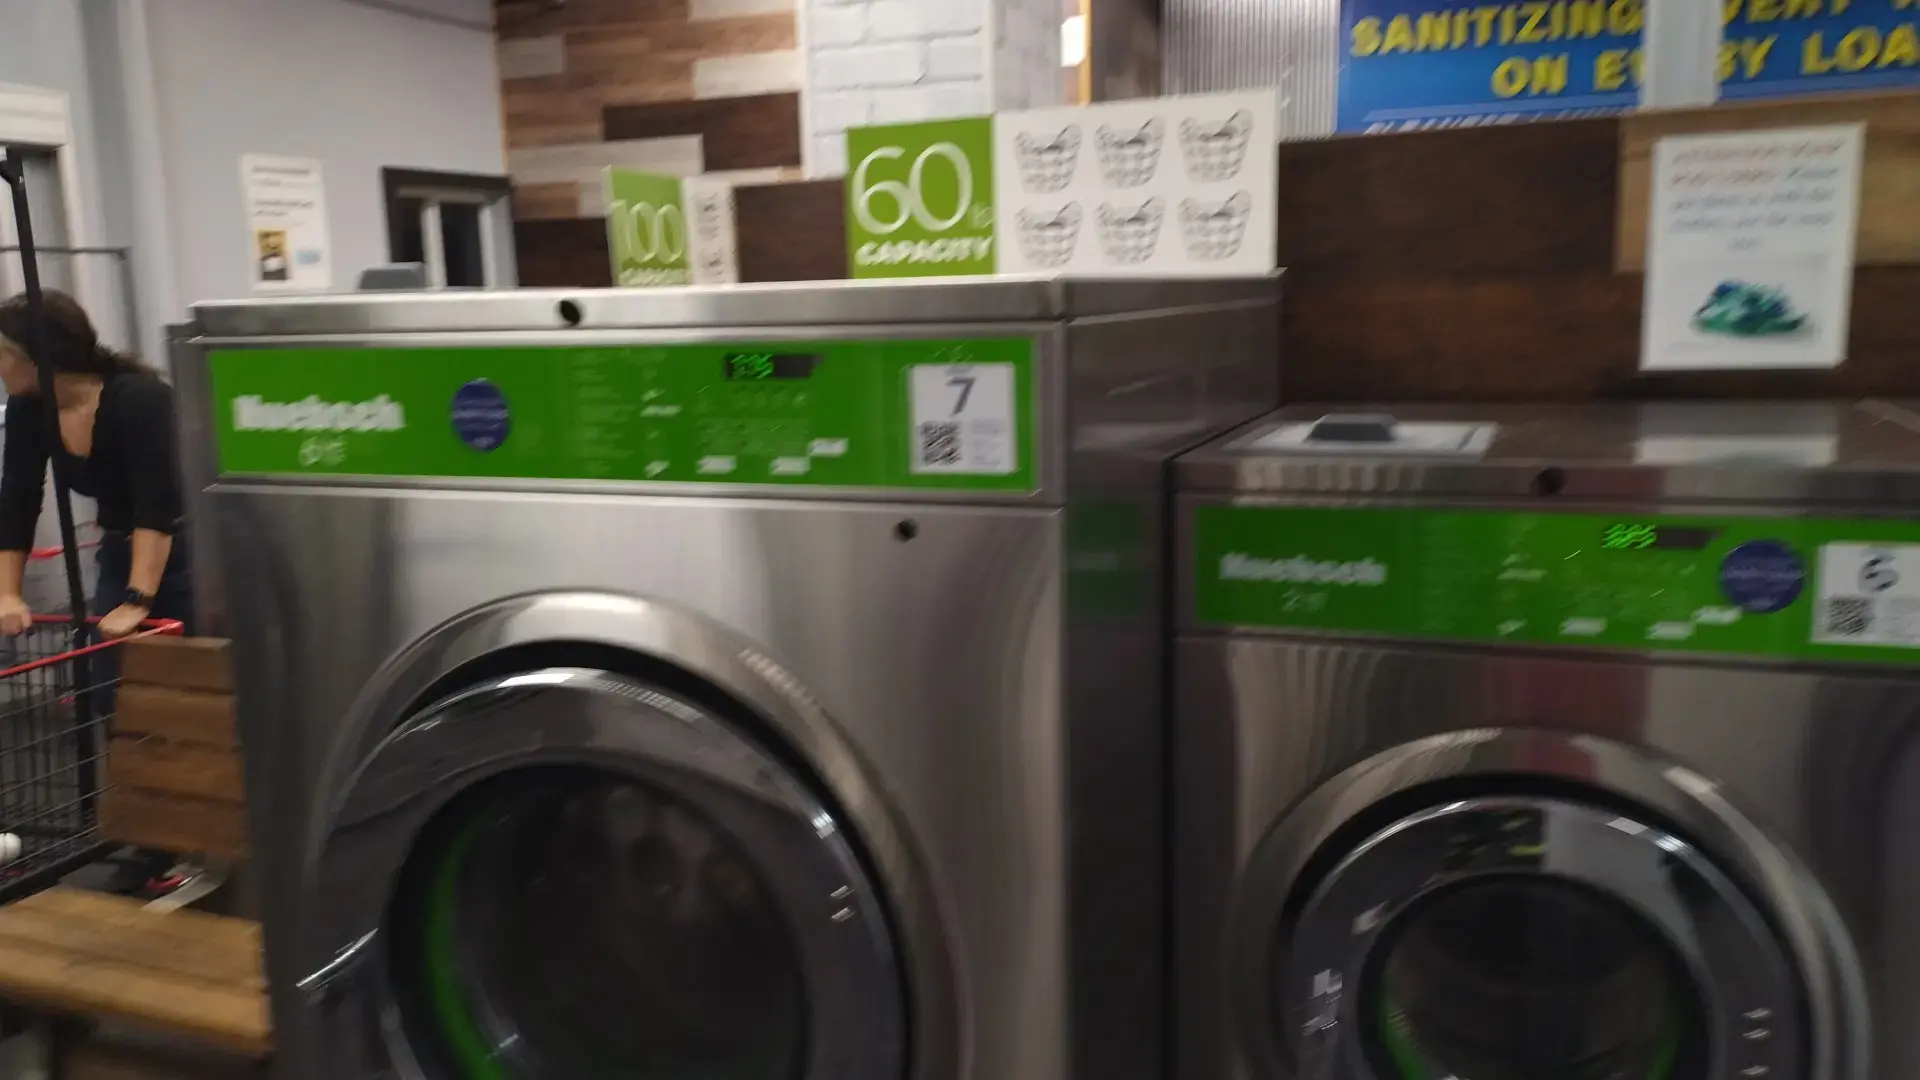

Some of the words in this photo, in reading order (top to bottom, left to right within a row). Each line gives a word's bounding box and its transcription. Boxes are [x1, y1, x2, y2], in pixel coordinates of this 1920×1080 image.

[1350, 0, 1643, 57] SANITIZING
[1491, 53, 1568, 98] ON
[852, 141, 974, 235] 60
[610, 199, 685, 265] 100
[855, 235, 994, 267] CAPACITY
[946, 376, 977, 416] 7
[1859, 554, 1900, 593] 6
